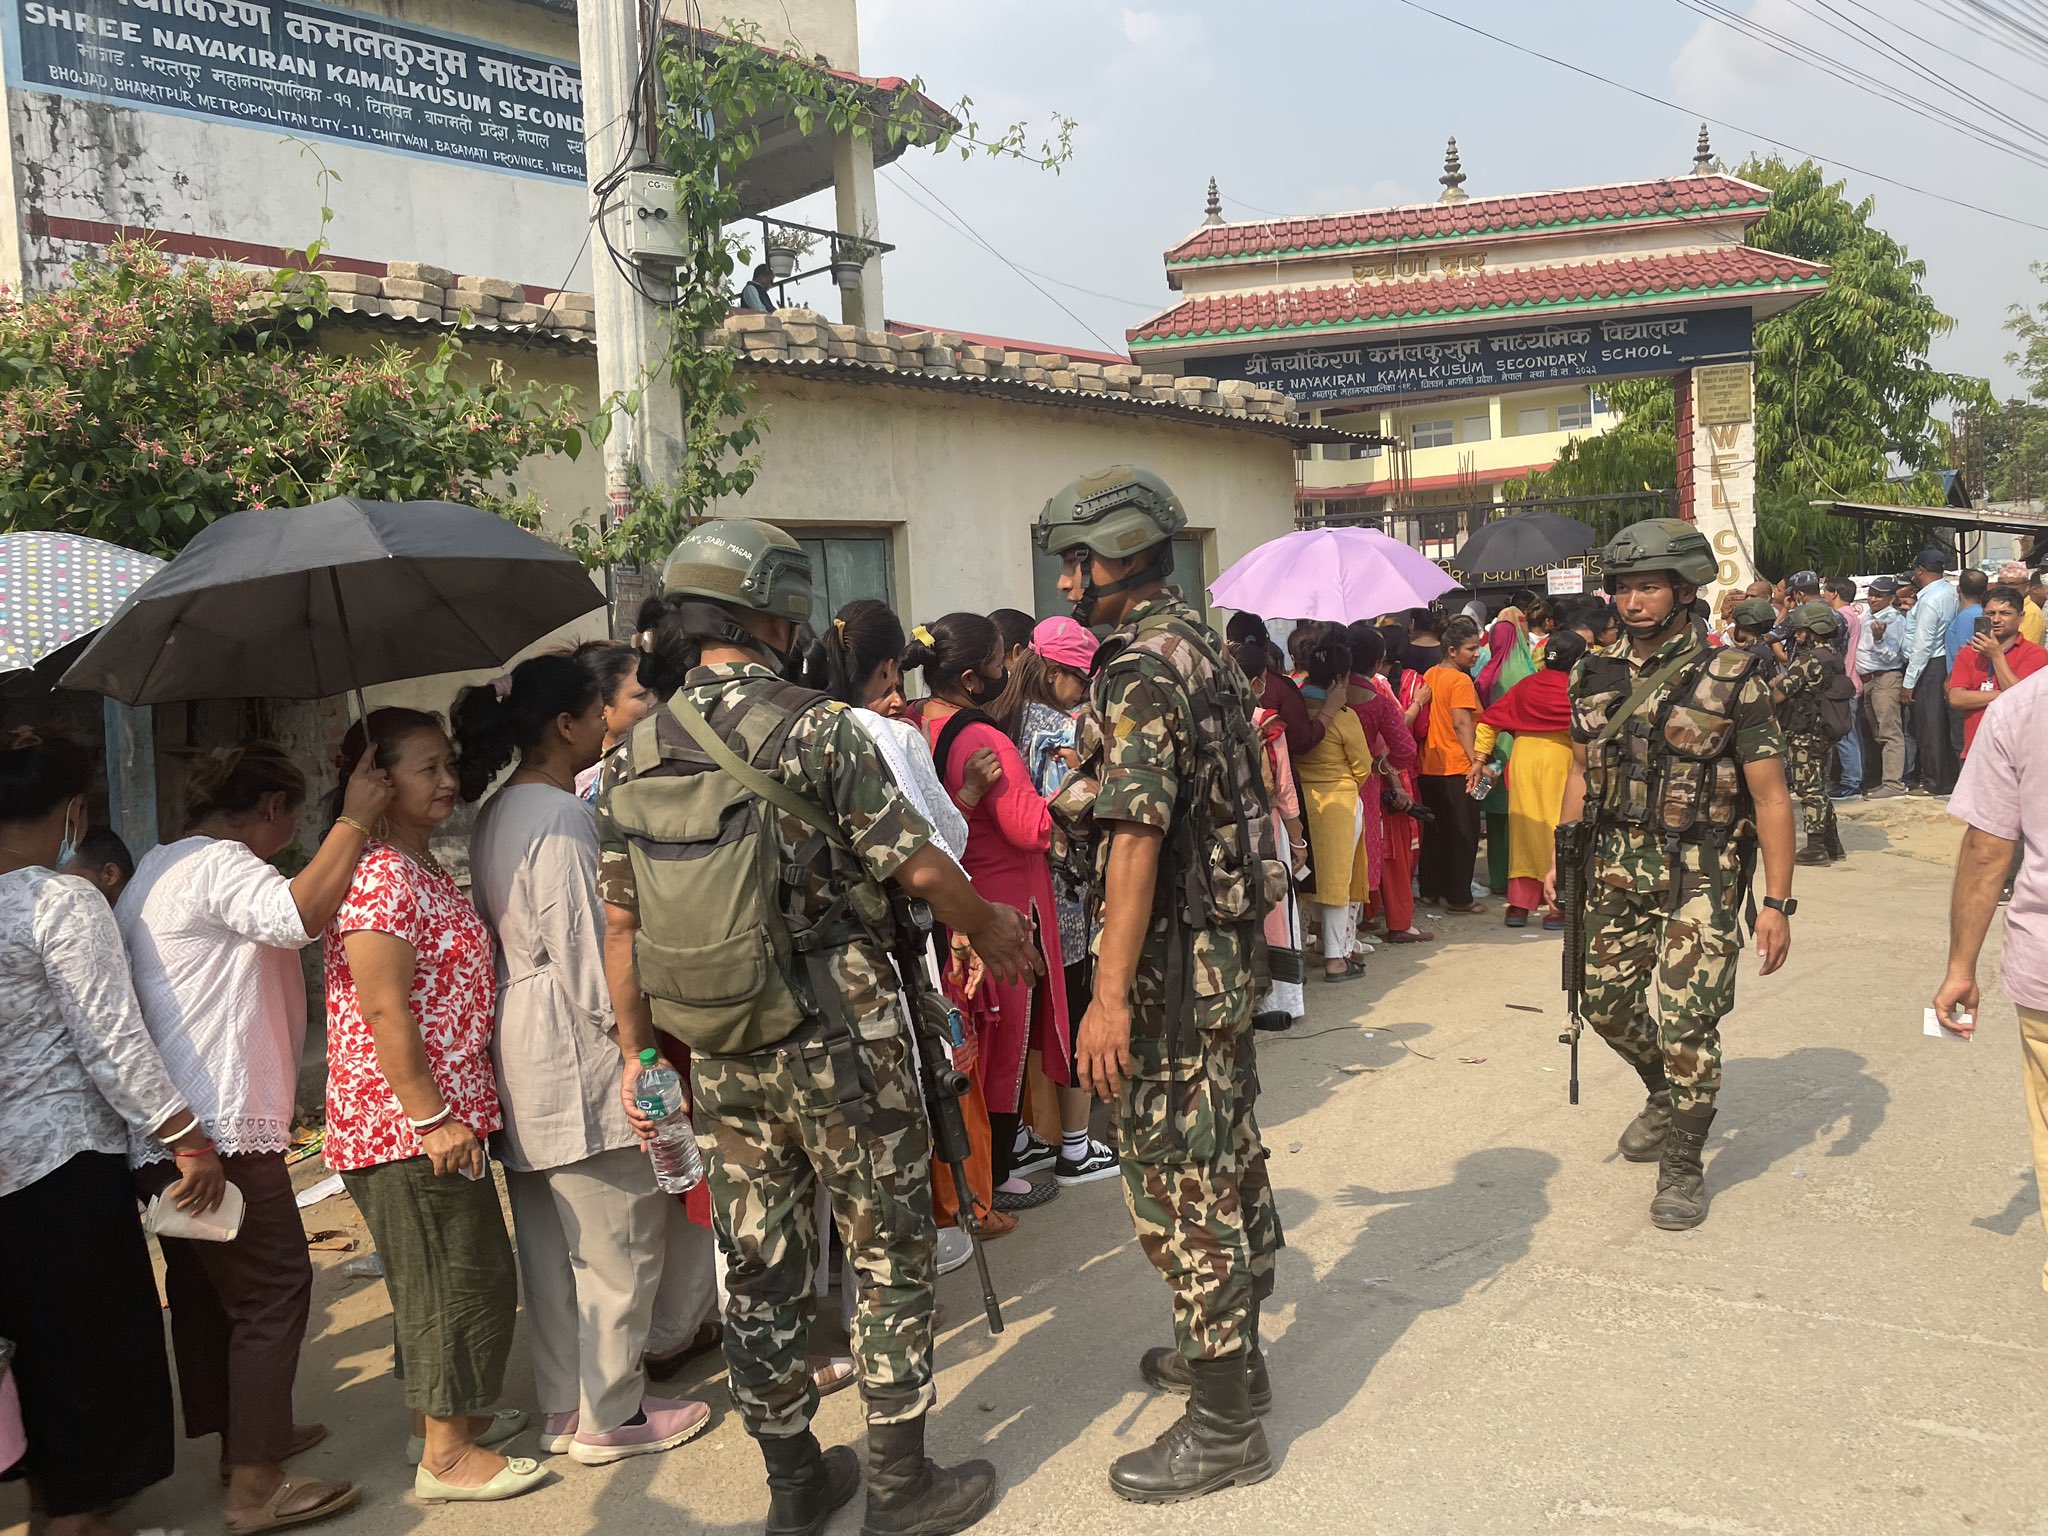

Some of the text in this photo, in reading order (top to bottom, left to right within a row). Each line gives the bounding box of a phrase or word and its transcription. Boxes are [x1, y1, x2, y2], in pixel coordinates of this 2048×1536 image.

[24, 2, 585, 134] SHREE NAYAKIRAN KAMALKUSUM SECOND
[140, 54, 202, 87] भरतपुर
[211, 68, 323, 102] महानगरपालिका
[424, 110, 472, 135] बागमती
[516, 124, 550, 150] नेपाल
[284, 11, 467, 86] कमलकुसुम
[478, 55, 584, 104] माध्यमि
[113, 77, 196, 108] BHARATPUR
[197, 93, 308, 127] METROPOLITAN
[435, 140, 488, 161] BAGAMATI
[551, 161, 586, 178] NEPAL
[1244, 352, 1269, 376] श्री
[1366, 338, 1482, 364] कमलकुसुम
[1488, 325, 1593, 352] माध्यमिक
[1599, 318, 1689, 342] विद्यालय
[1290, 372, 1366, 390] NAYAKIRAN
[1377, 361, 1485, 385] KAMALKUSUM
[1496, 350, 1589, 372] SECONDARY
[1601, 343, 1673, 361] SCHOOL
[704, 535, 725, 546] SARU
